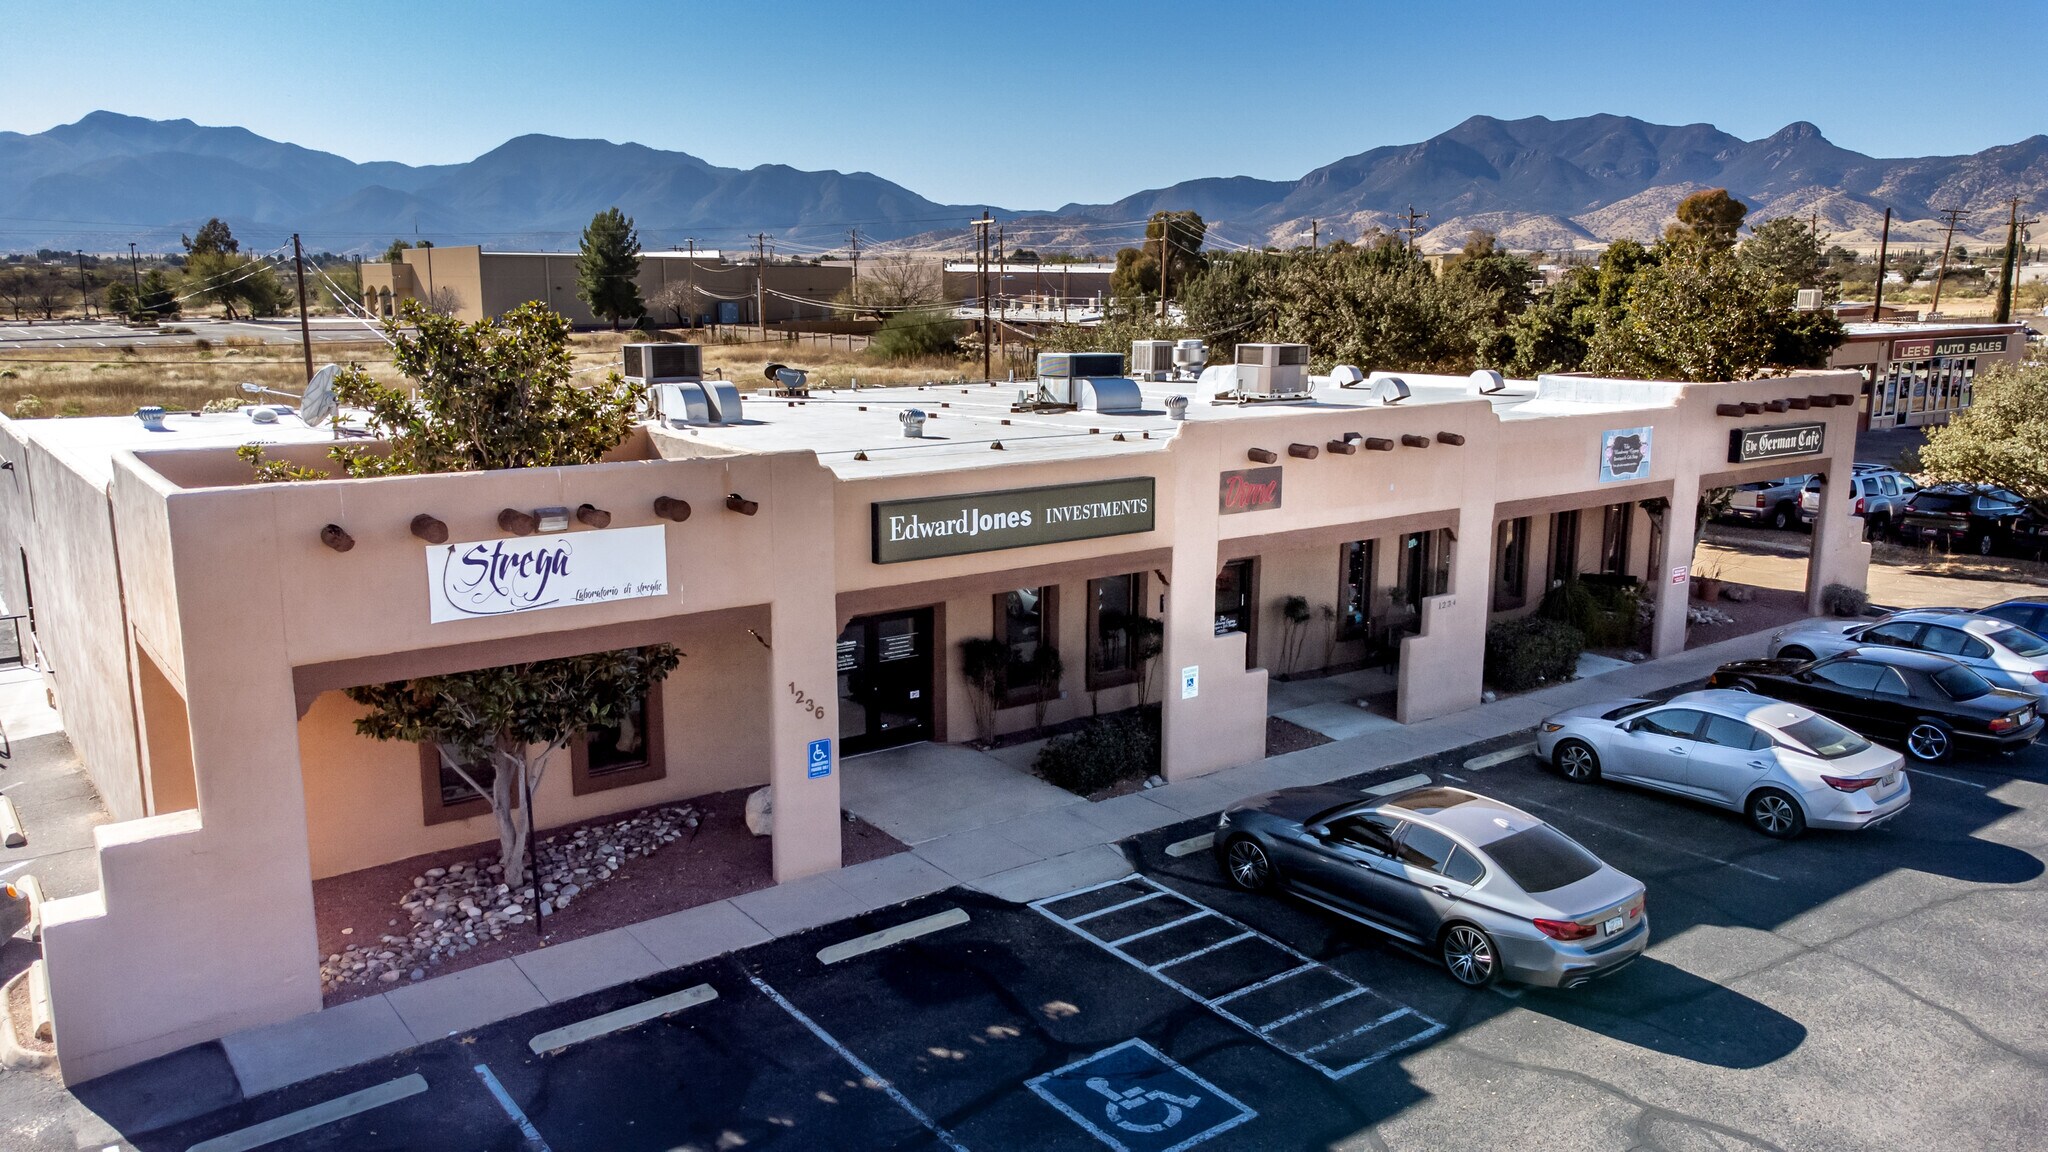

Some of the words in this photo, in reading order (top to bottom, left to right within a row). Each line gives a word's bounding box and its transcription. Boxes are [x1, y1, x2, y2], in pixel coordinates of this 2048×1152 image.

[1902, 345, 1931, 358] LEE'S
[1935, 343, 1965, 355] AUTO
[1969, 341, 2002, 353] SALES
[1745, 440, 1757, 454] The
[1759, 434, 1797, 455] German
[1046, 498, 1148, 524] INVESTMENTS
[455, 540, 571, 604] Strega
[572, 586, 619, 601] Laboratorio
[624, 582, 632, 594] di
[789, 681, 825, 719] 1236
